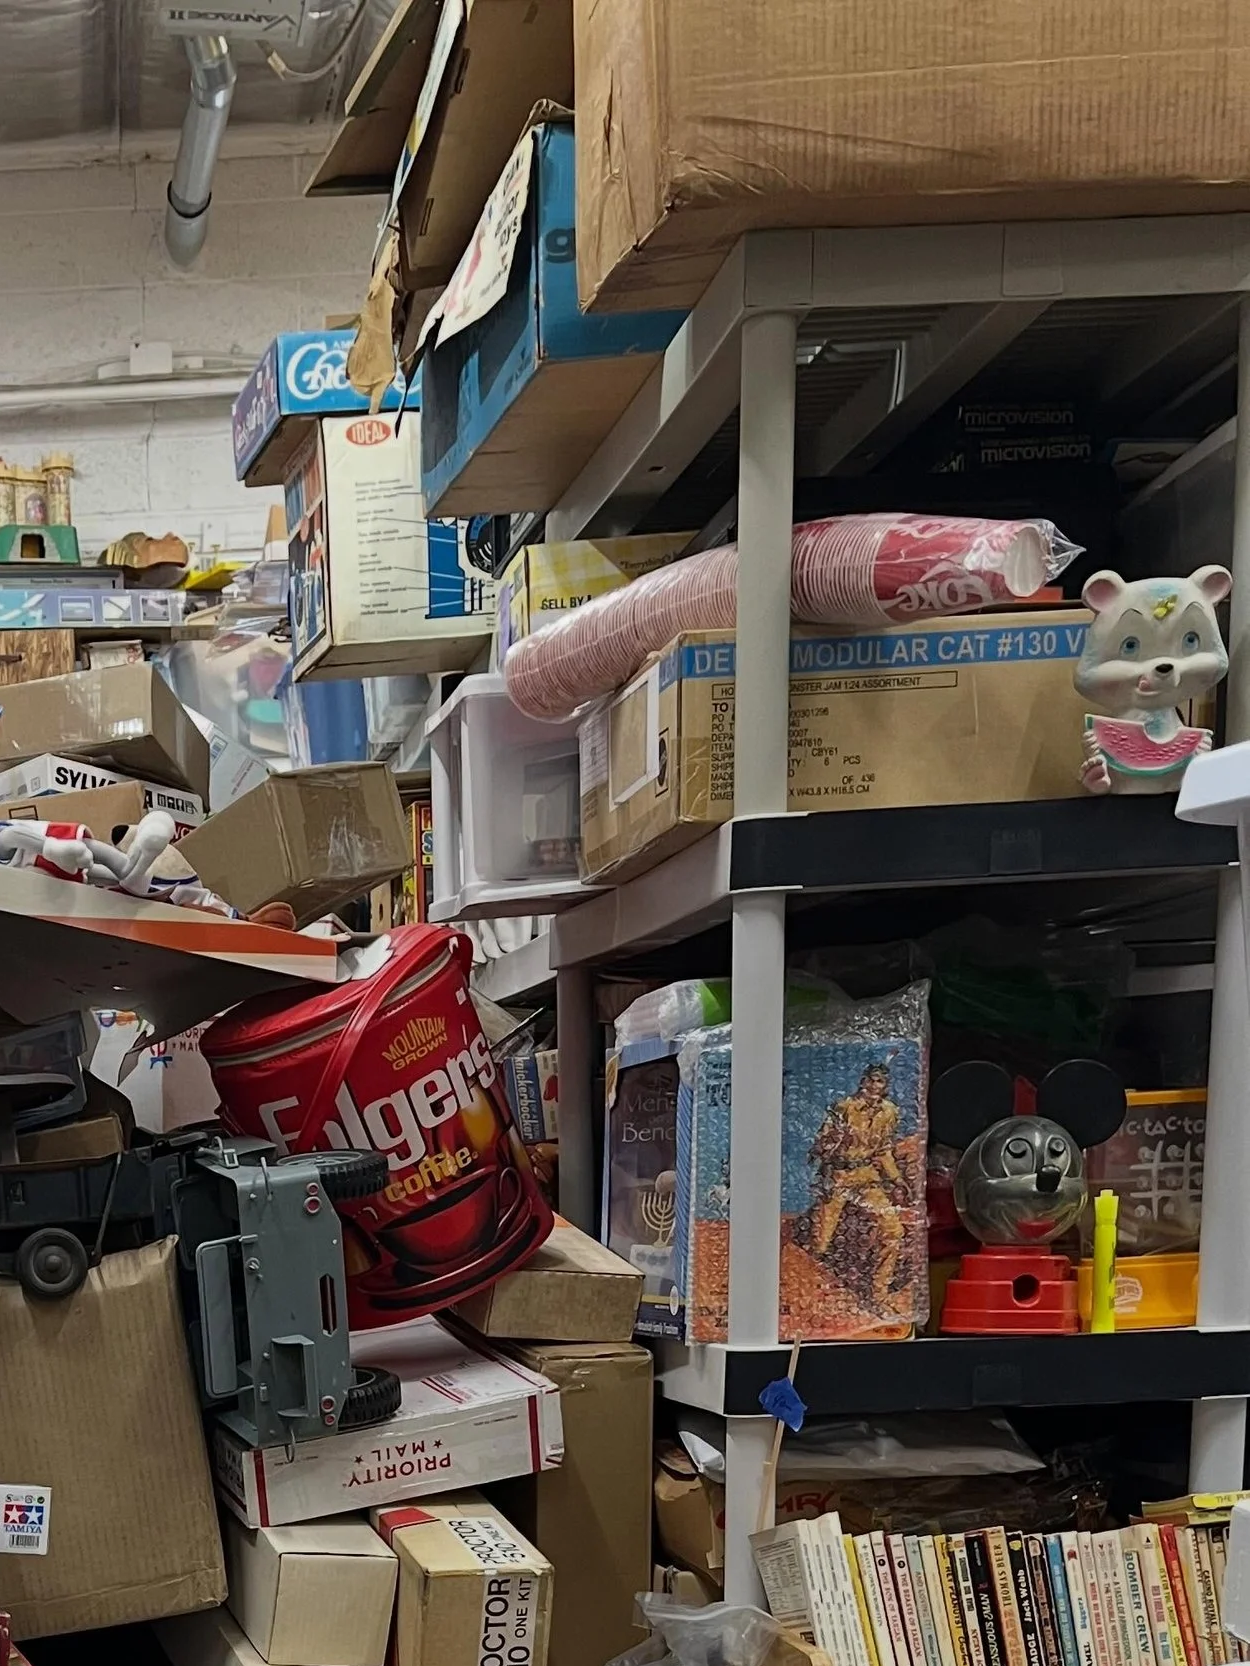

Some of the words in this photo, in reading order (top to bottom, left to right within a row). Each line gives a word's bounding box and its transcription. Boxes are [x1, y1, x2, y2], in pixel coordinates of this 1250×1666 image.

[964, 408, 1074, 426] microvision
[352, 423, 384, 443] IDEAL
[980, 442, 1091, 463] microvision
[541, 596, 568, 611] SELL
[793, 638, 928, 669] MODULAR
[938, 635, 990, 661] CAT
[997, 630, 1056, 657] #130
[861, 677, 921, 688] ASSORTMENT
[843, 755, 861, 765] PCS
[380, 1017, 446, 1063] MOUNTAIN
[392, 1032, 448, 1070] GROWN
[372, 1441, 425, 1462] MAIL
[348, 1453, 452, 1488] PRIORITY
[4, 1524, 43, 1534] TAMIYA
[516, 1578, 532, 1600] KIT
[1017, 1569, 1028, 1597] Webb
[1125, 1551, 1142, 1610] BOMBER
[1136, 1615, 1151, 1654] CREW
[516, 1604, 528, 1640] ONE
